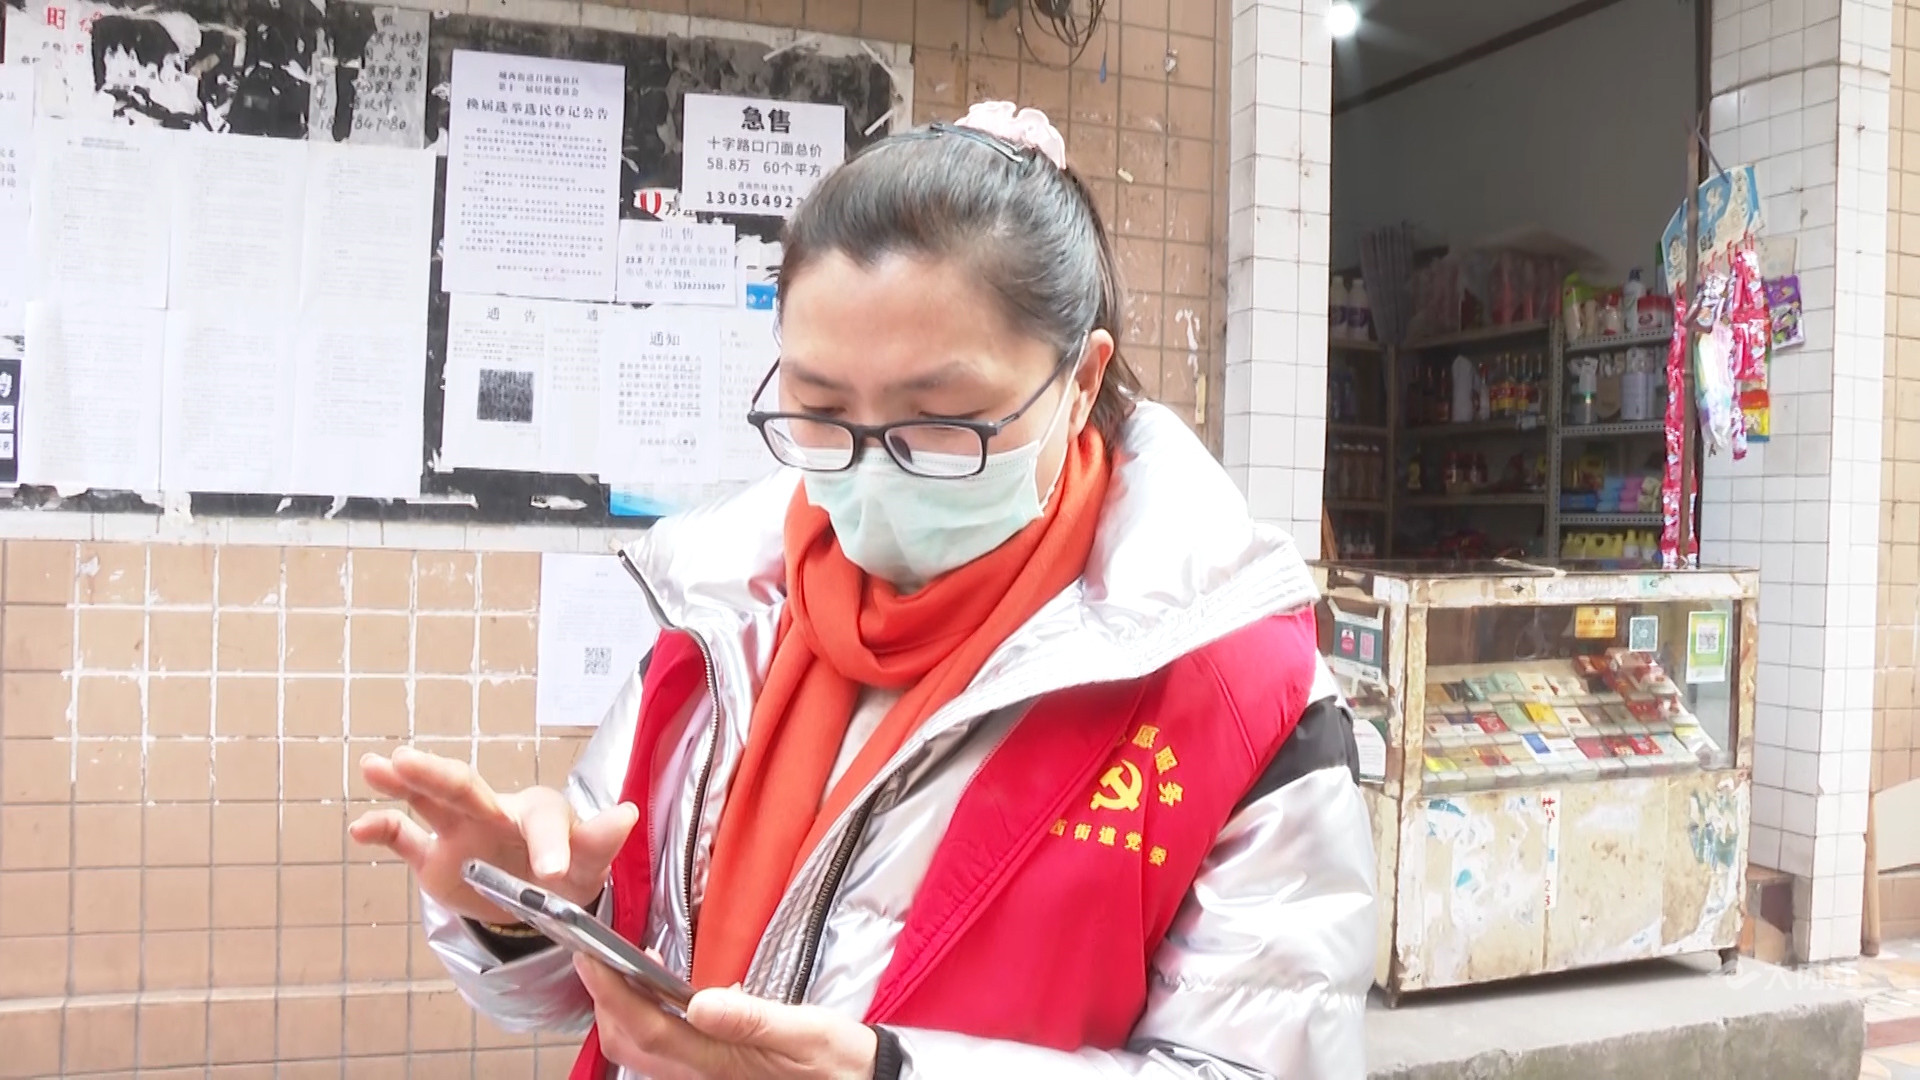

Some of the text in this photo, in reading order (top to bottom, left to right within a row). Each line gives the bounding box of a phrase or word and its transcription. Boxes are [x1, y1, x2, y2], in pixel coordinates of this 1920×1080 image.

[466, 97, 609, 120] 换届选举选民登记公告
[741, 105, 792, 134] 急售
[706, 136, 823, 158] 十字路口门面总价
[706, 157, 822, 177] 58.8万 60个平方
[649, 331, 681, 347] 通知
[1116, 724, 1184, 807] 愿服务
